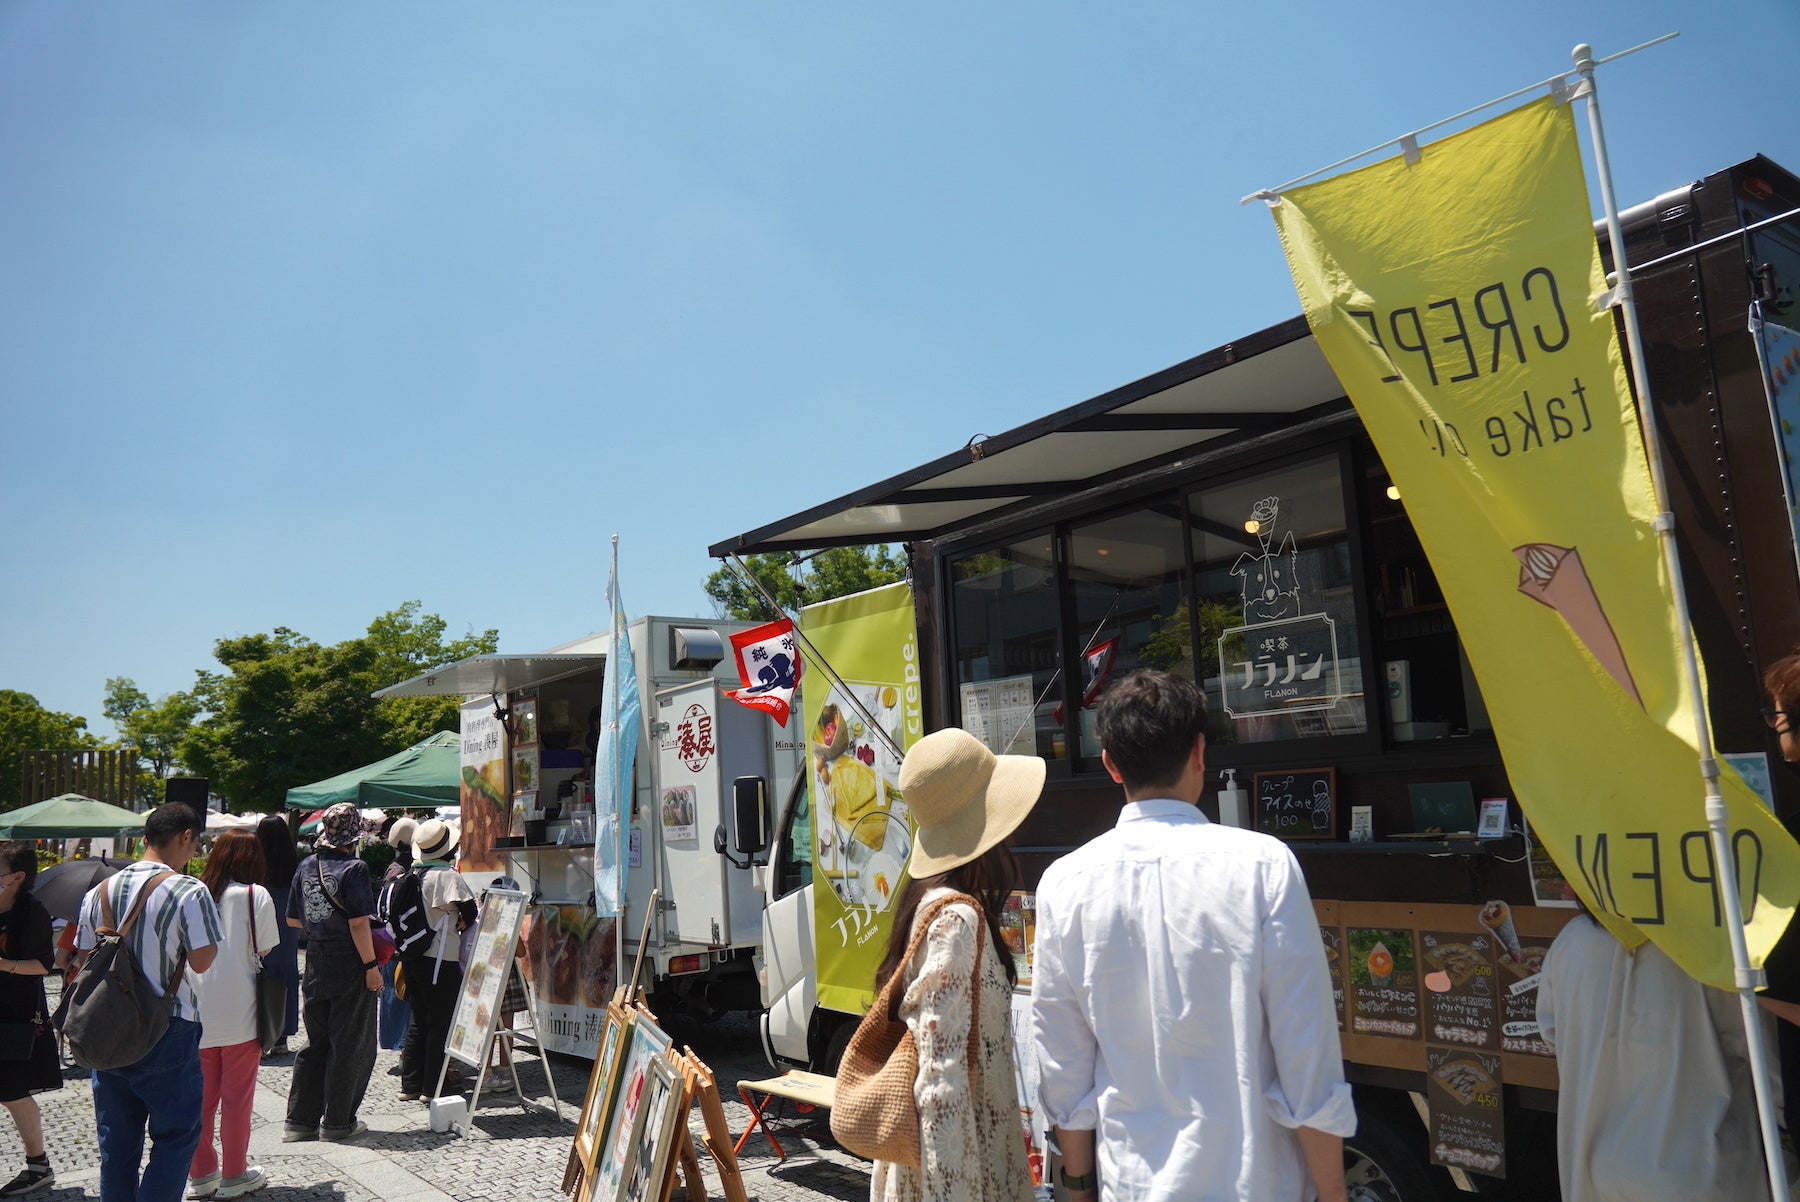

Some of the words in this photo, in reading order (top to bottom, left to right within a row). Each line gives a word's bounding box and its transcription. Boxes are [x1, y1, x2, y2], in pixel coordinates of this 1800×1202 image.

[1260, 636, 1290, 653] 喫茶
[752, 646, 769, 662] 純
[1232, 653, 1324, 690] フラノン
[903, 632, 922, 735] crepe.
[1264, 687, 1299, 699] FLANON
[463, 738, 483, 755] Dining
[1262, 775, 1295, 793] クレープ
[1261, 793, 1314, 811] アイスのせ
[830, 882, 889, 948] フラノン
[856, 923, 879, 948] FLANON
[1474, 966, 1492, 976] 600
[542, 1010, 581, 1043] Dining
[1434, 1024, 1488, 1046] キャラモンド
[1477, 1093, 1498, 1108] 450
